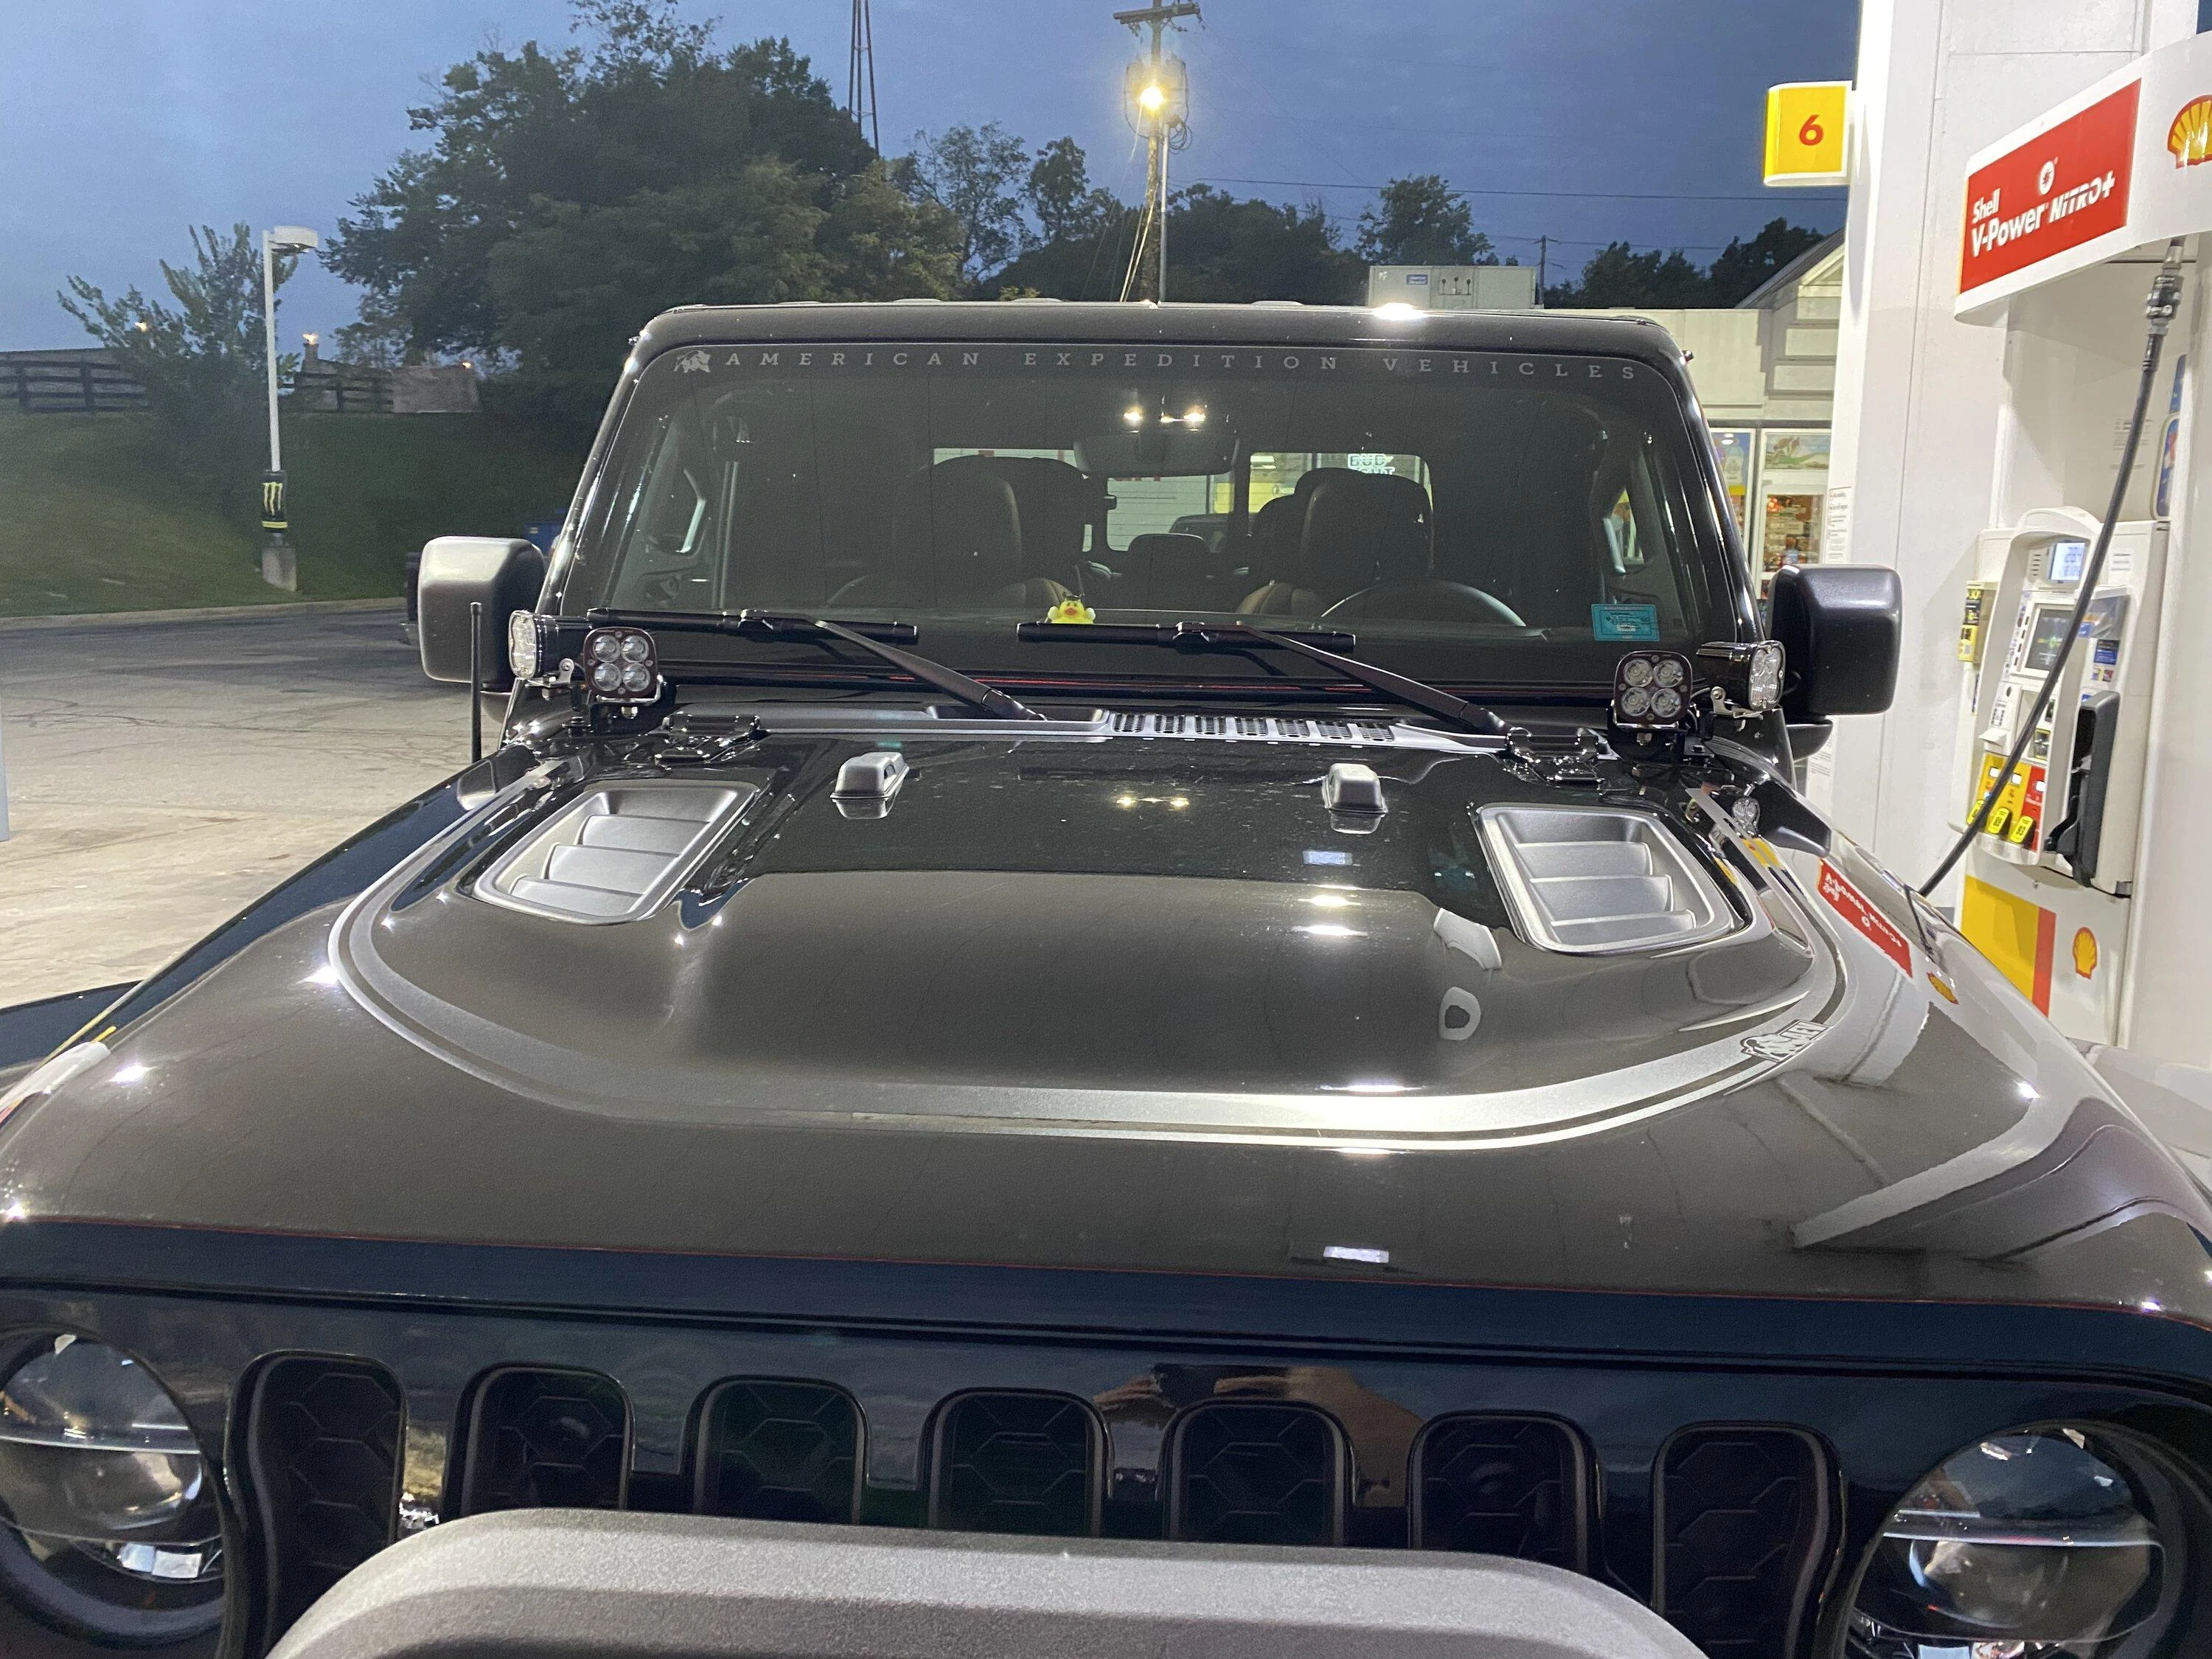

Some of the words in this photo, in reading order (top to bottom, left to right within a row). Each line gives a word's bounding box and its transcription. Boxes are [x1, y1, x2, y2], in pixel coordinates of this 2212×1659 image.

[1799, 114, 1824, 146] 6
[1972, 187, 2000, 223] Shell
[1971, 204, 2045, 257] V-Power
[725, 352, 979, 366] AMERICAN
[1023, 352, 1337, 369] EXPEDITION
[1382, 358, 1634, 380] VEHICLES
[1348, 453, 1386, 468] BUD
